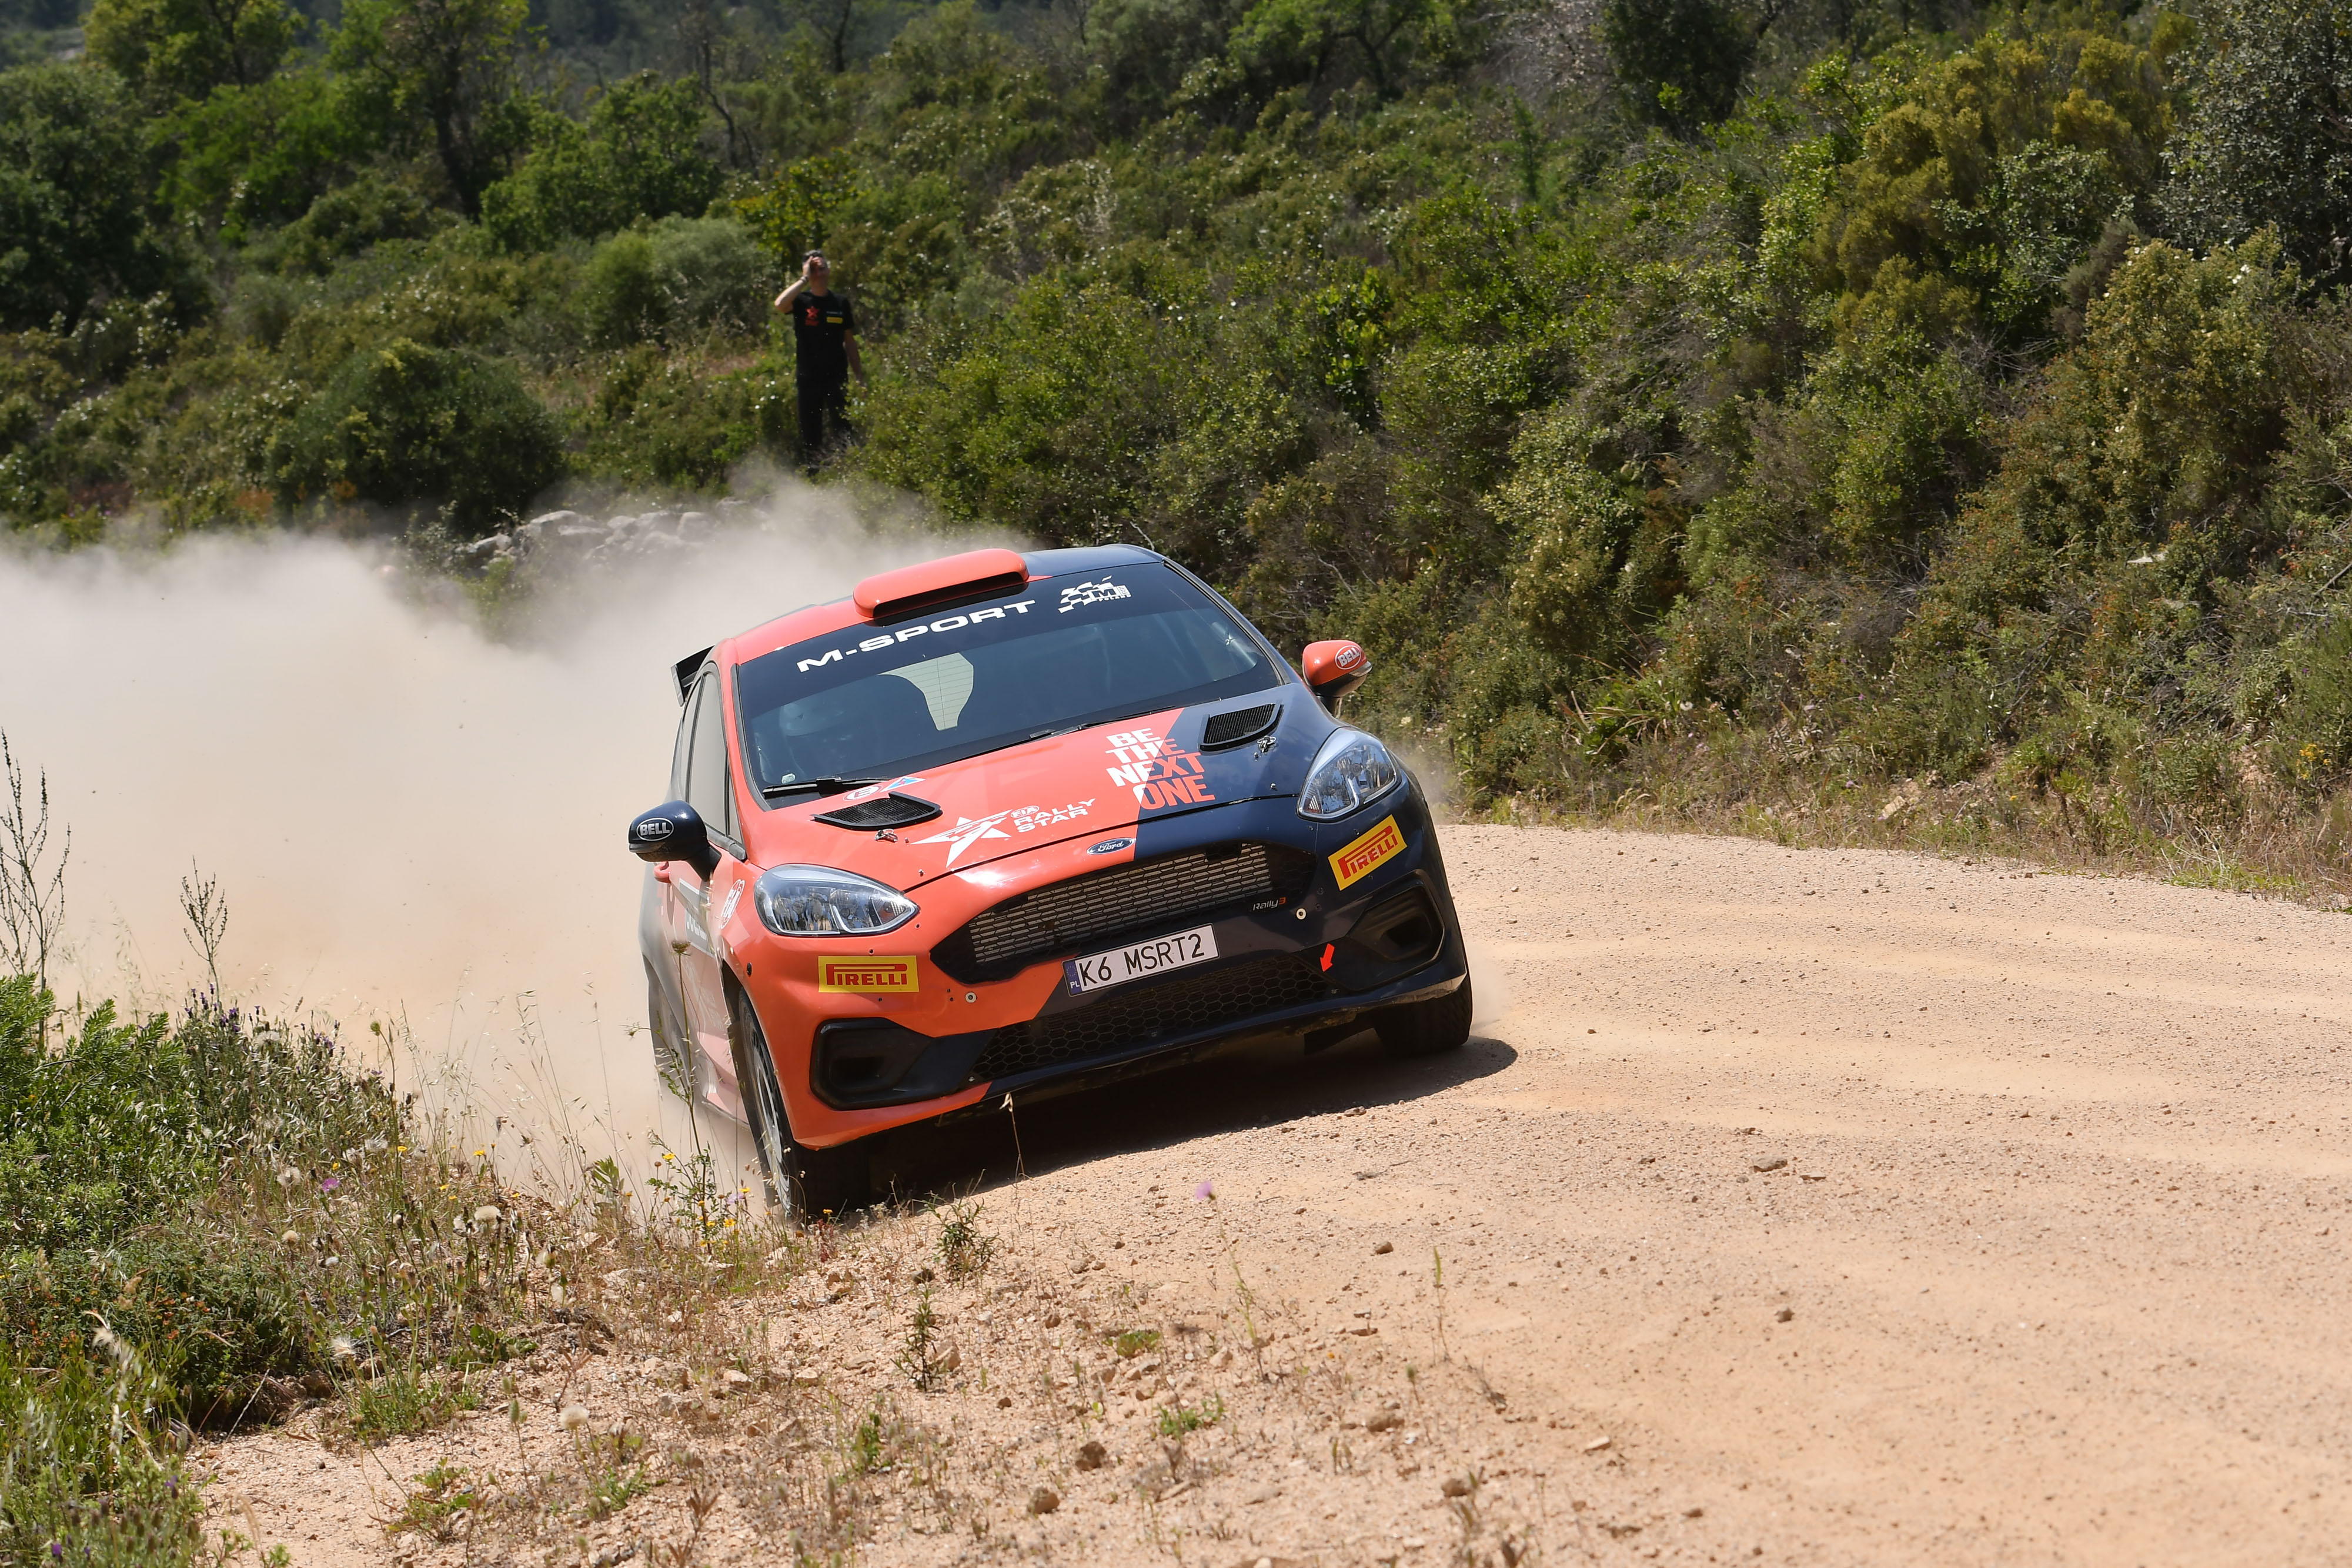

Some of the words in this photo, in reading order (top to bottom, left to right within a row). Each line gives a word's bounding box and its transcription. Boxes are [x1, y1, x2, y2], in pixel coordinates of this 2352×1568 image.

[796, 600, 1035, 673] M-SPORT
[1337, 647, 1360, 667] BELL
[1106, 728, 1161, 748] BE
[1105, 738, 1185, 764] THE
[1106, 752, 1205, 787] NEXT
[1132, 774, 1215, 810] ONE
[1011, 806, 1038, 817] FIA
[1013, 798, 1096, 827] RALLY
[1017, 808, 1089, 833] STAR
[640, 822, 670, 837] BELL
[1097, 841, 1124, 852] Ford
[1337, 825, 1398, 880] PIRELLI
[1079, 957, 1112, 987] K6
[1124, 934, 1205, 975] MSRT2
[826, 963, 908, 985] PIRELLI
